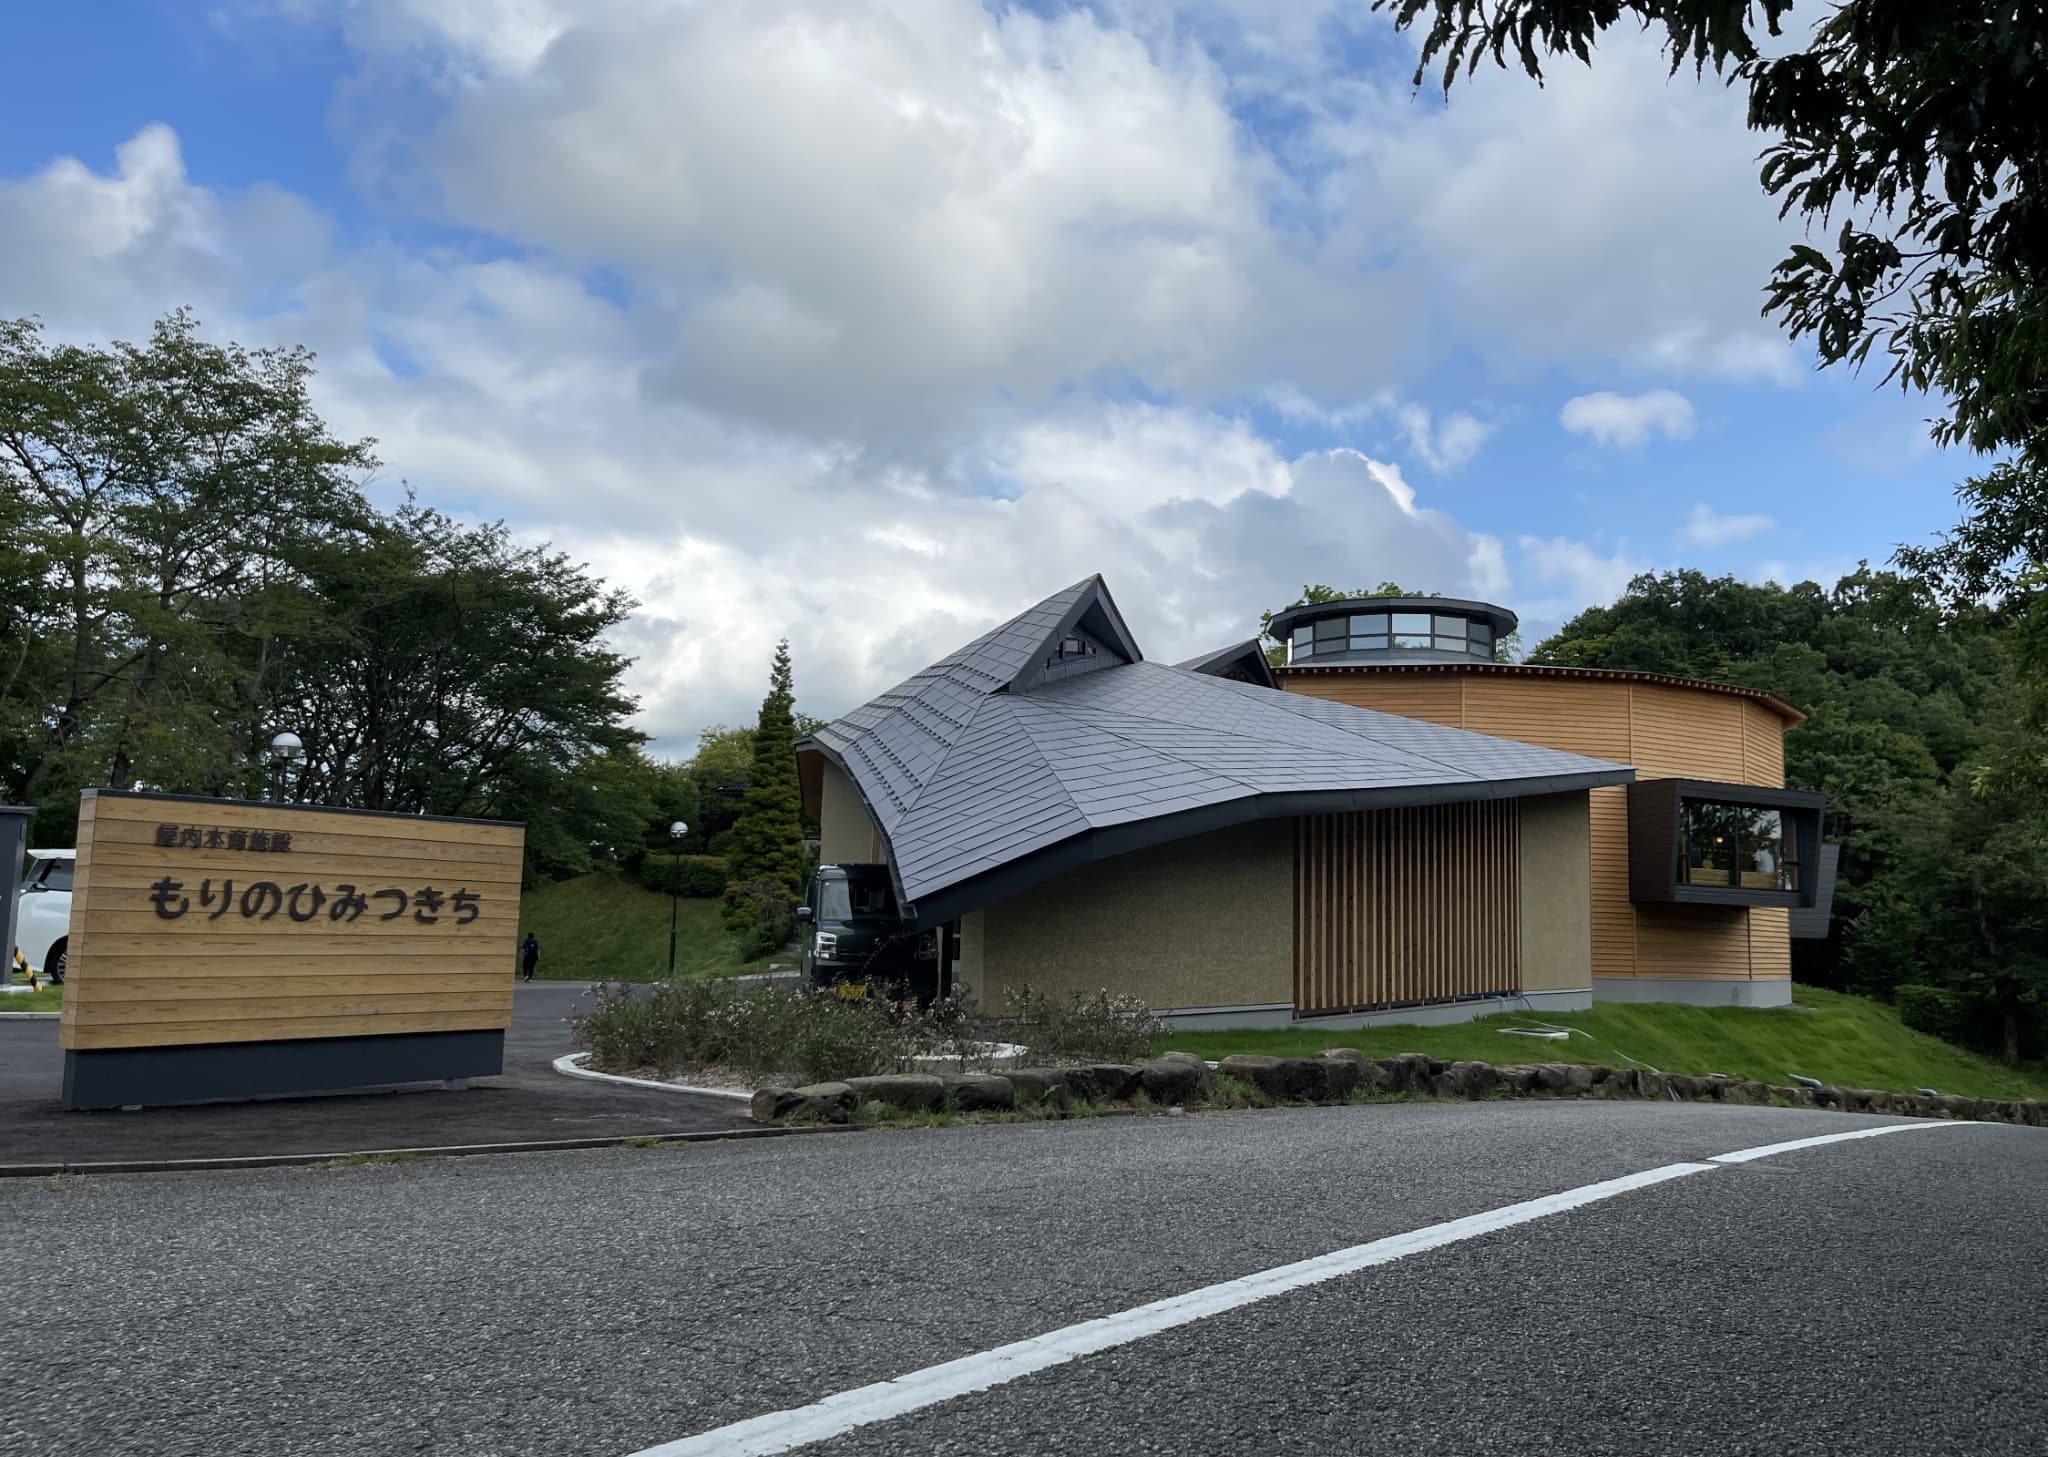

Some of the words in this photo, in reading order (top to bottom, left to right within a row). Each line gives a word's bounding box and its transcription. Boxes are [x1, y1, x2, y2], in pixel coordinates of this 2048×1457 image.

[150, 876, 482, 925] もりのひみつきち
